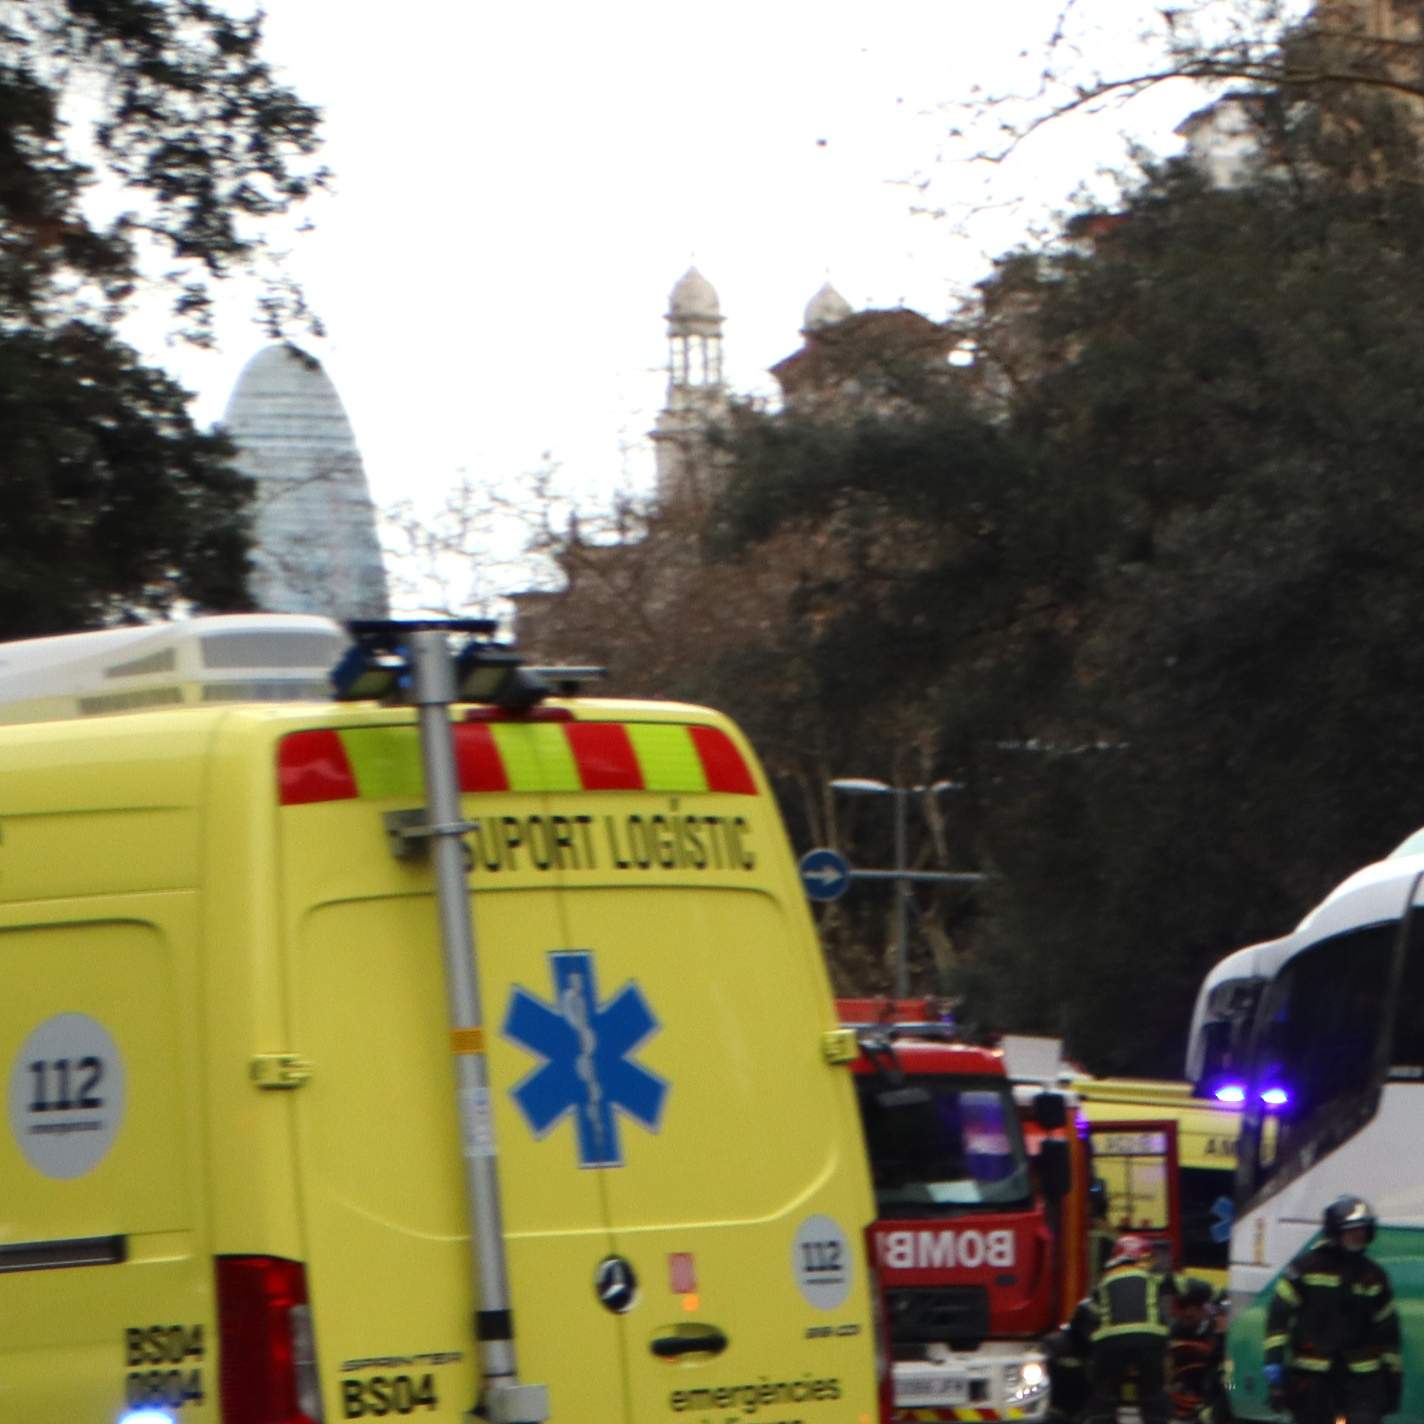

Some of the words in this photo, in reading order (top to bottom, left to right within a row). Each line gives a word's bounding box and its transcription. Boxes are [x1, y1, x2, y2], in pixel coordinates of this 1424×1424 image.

[604, 798, 756, 871] LOGÍSTIC
[29, 1056, 105, 1113] 112
[801, 1241, 843, 1272] 112
[125, 1324, 206, 1366] BS04
[342, 1373, 438, 1419] BS04
[671, 1374, 842, 1414] emergències
